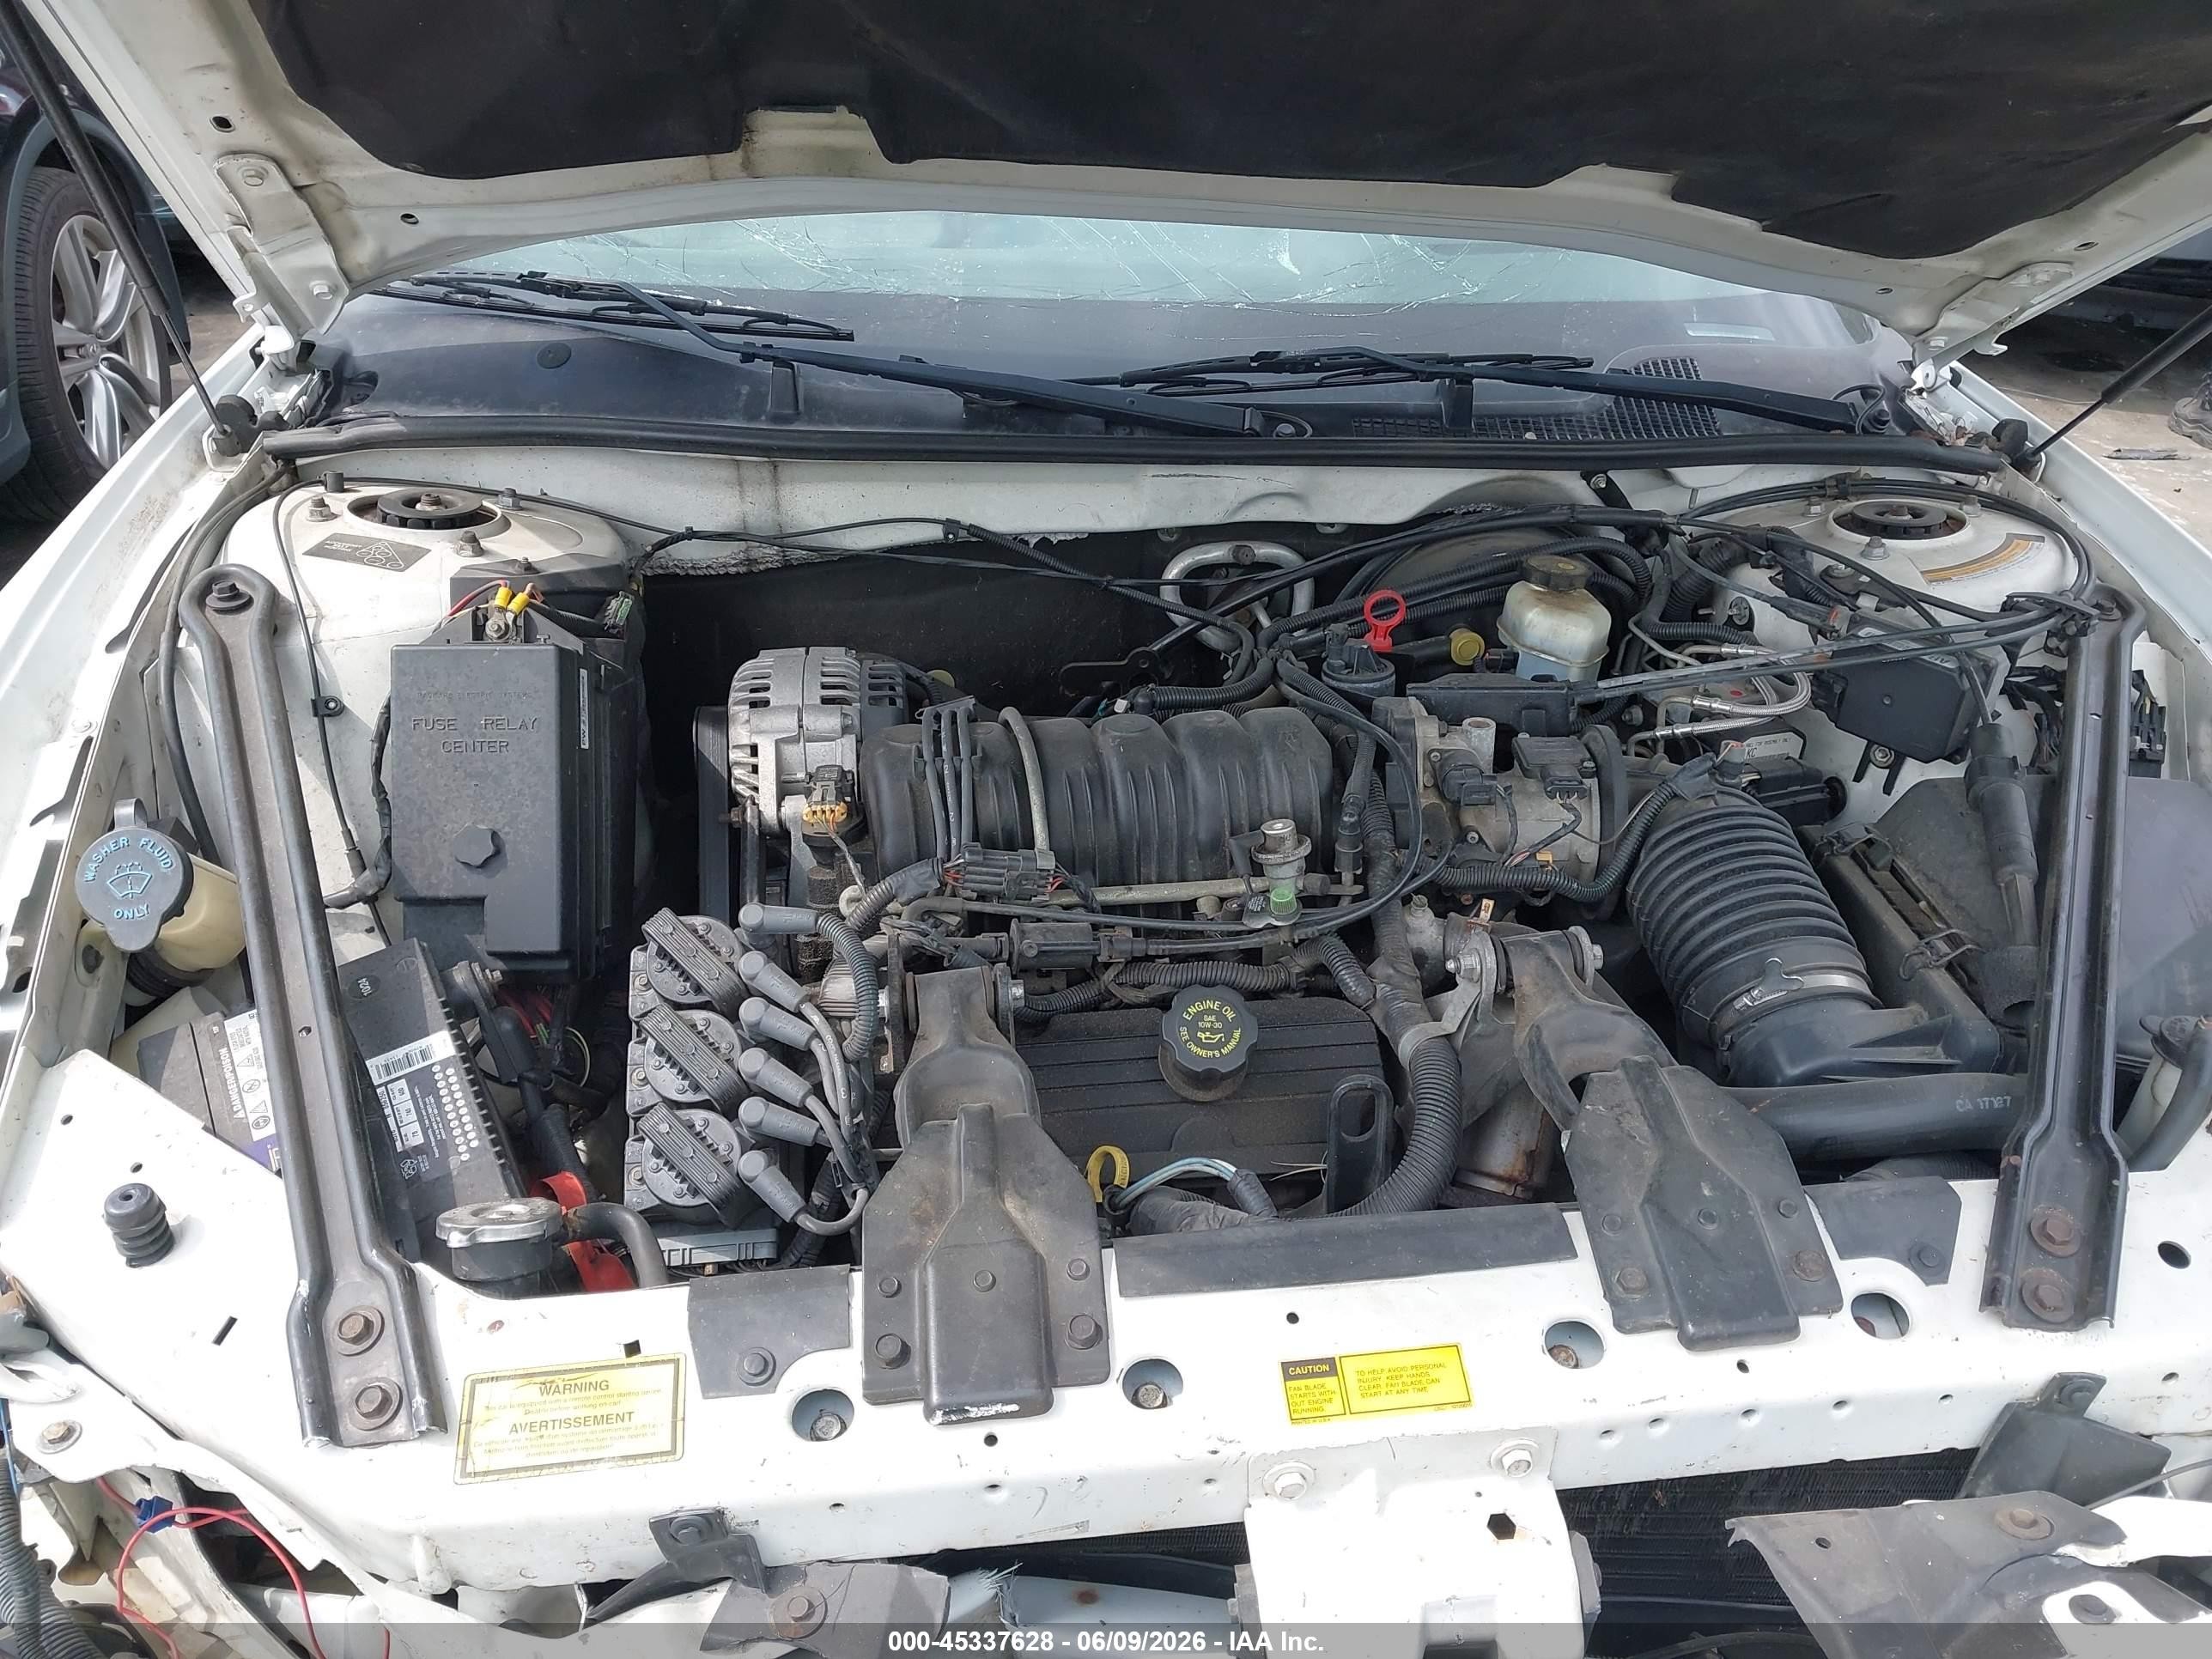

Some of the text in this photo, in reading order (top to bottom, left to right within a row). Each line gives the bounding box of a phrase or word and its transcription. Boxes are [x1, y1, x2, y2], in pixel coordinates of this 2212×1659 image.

[411, 716, 538, 732] FUSE RELAY
[441, 739, 509, 755] CENTER
[83, 836, 175, 883] WASHER FLUID
[113, 902, 150, 921] ONLY
[1182, 1000, 1237, 1023] ENGINE OIL
[1180, 1026, 1241, 1058] SEE OWNER'S MANUAL
[218, 1047, 243, 1113] DANGER/POISON
[1289, 1364, 1330, 1376] CAUTION
[1411, 1363, 1447, 1372] PERSONAL
[539, 1379, 610, 1397] WARNING
[1304, 1382, 1327, 1391] BLADE
[1290, 1391, 1316, 1401] STARTS
[1308, 1397, 1334, 1406] ENGINE
[509, 1411, 635, 1435] AVERTISSEMENT
